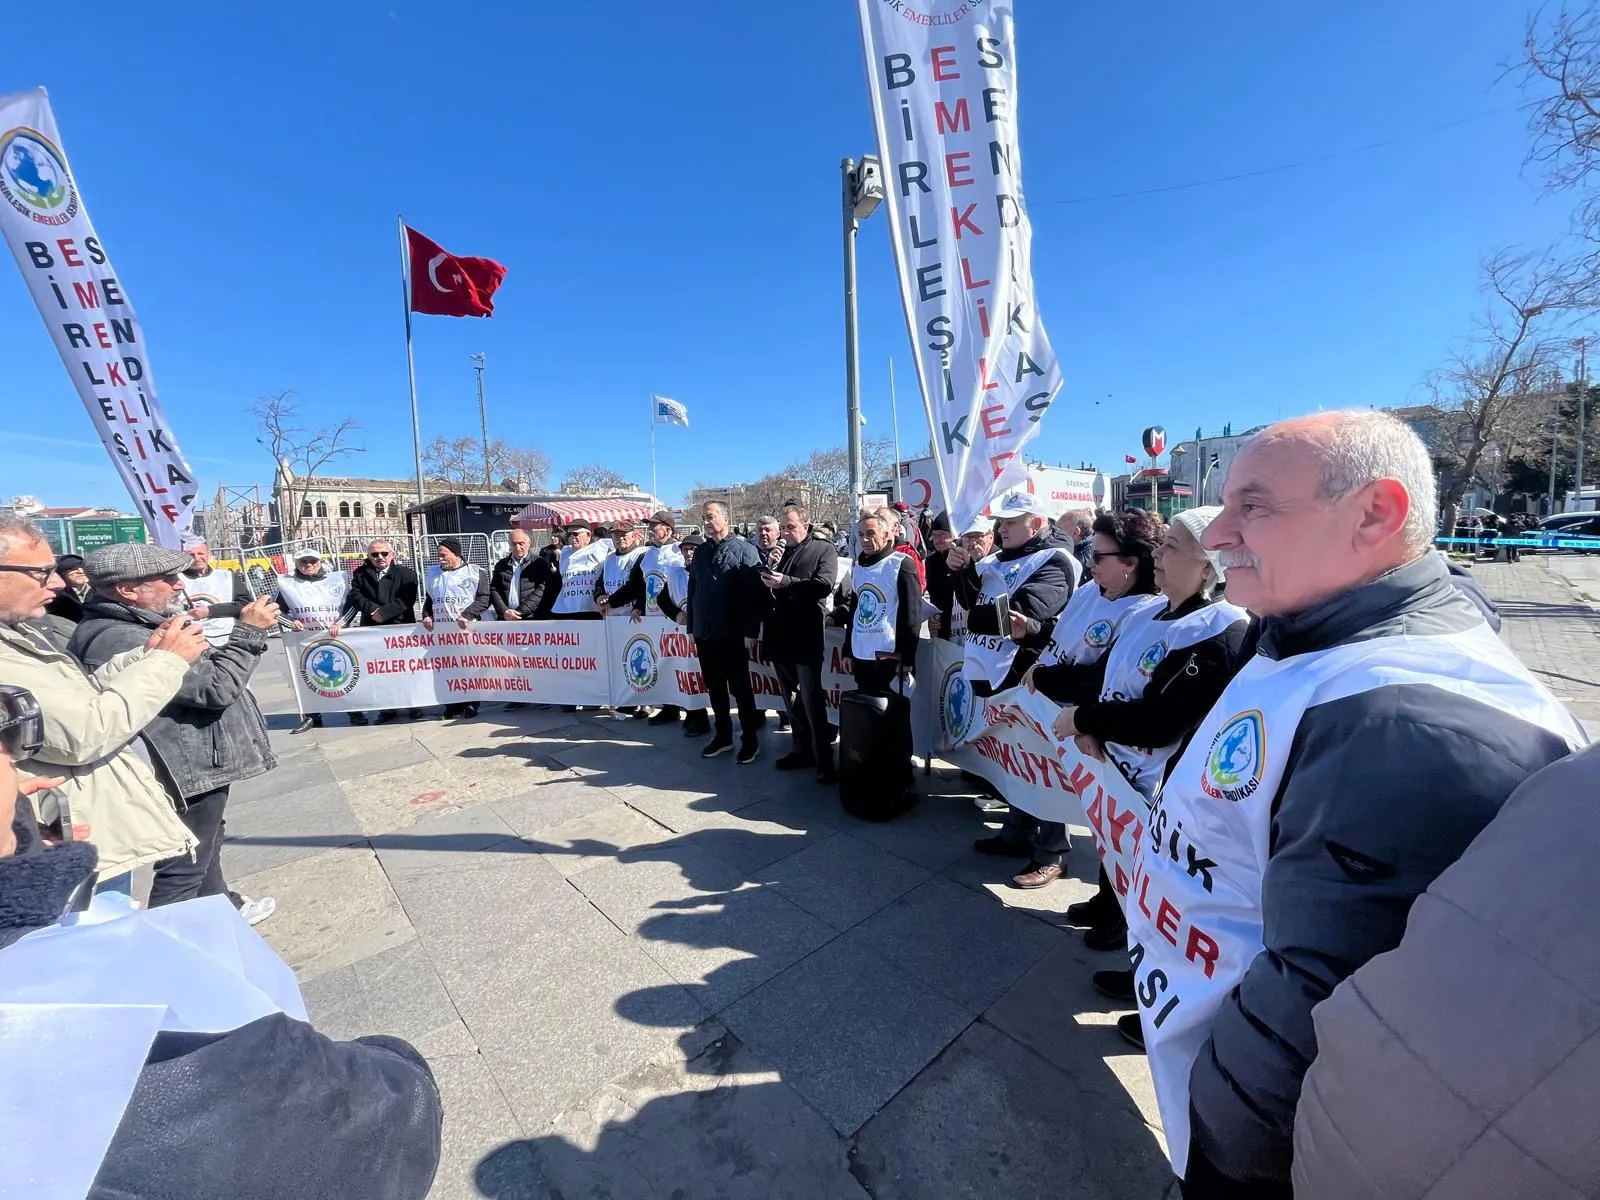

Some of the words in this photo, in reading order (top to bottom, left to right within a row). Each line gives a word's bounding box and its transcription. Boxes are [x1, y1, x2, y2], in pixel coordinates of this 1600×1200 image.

[902, 4, 971, 26] EMEKLİLER
[883, 53, 971, 455] BİRLEŞİK
[25, 241, 158, 520] BİRLEŞİK
[1152, 428, 1165, 450] M
[1051, 490, 1077, 501] CANDAN
[384, 634, 436, 651] YAŞASAK
[438, 632, 470, 647] HAYAT
[472, 630, 504, 646] ÖLSEK
[506, 633, 541, 646] MEZAR
[544, 633, 580, 646] PAHALI
[366, 658, 406, 675] BİZLER
[409, 656, 457, 675] ÇALIŞMA
[460, 655, 521, 669] HAYATINDAN
[523, 653, 559, 670] EMEKLİ
[561, 657, 597, 671] OLDUK
[446, 677, 502, 695] YAŞAMDAN
[504, 675, 533, 692] DEĞİL
